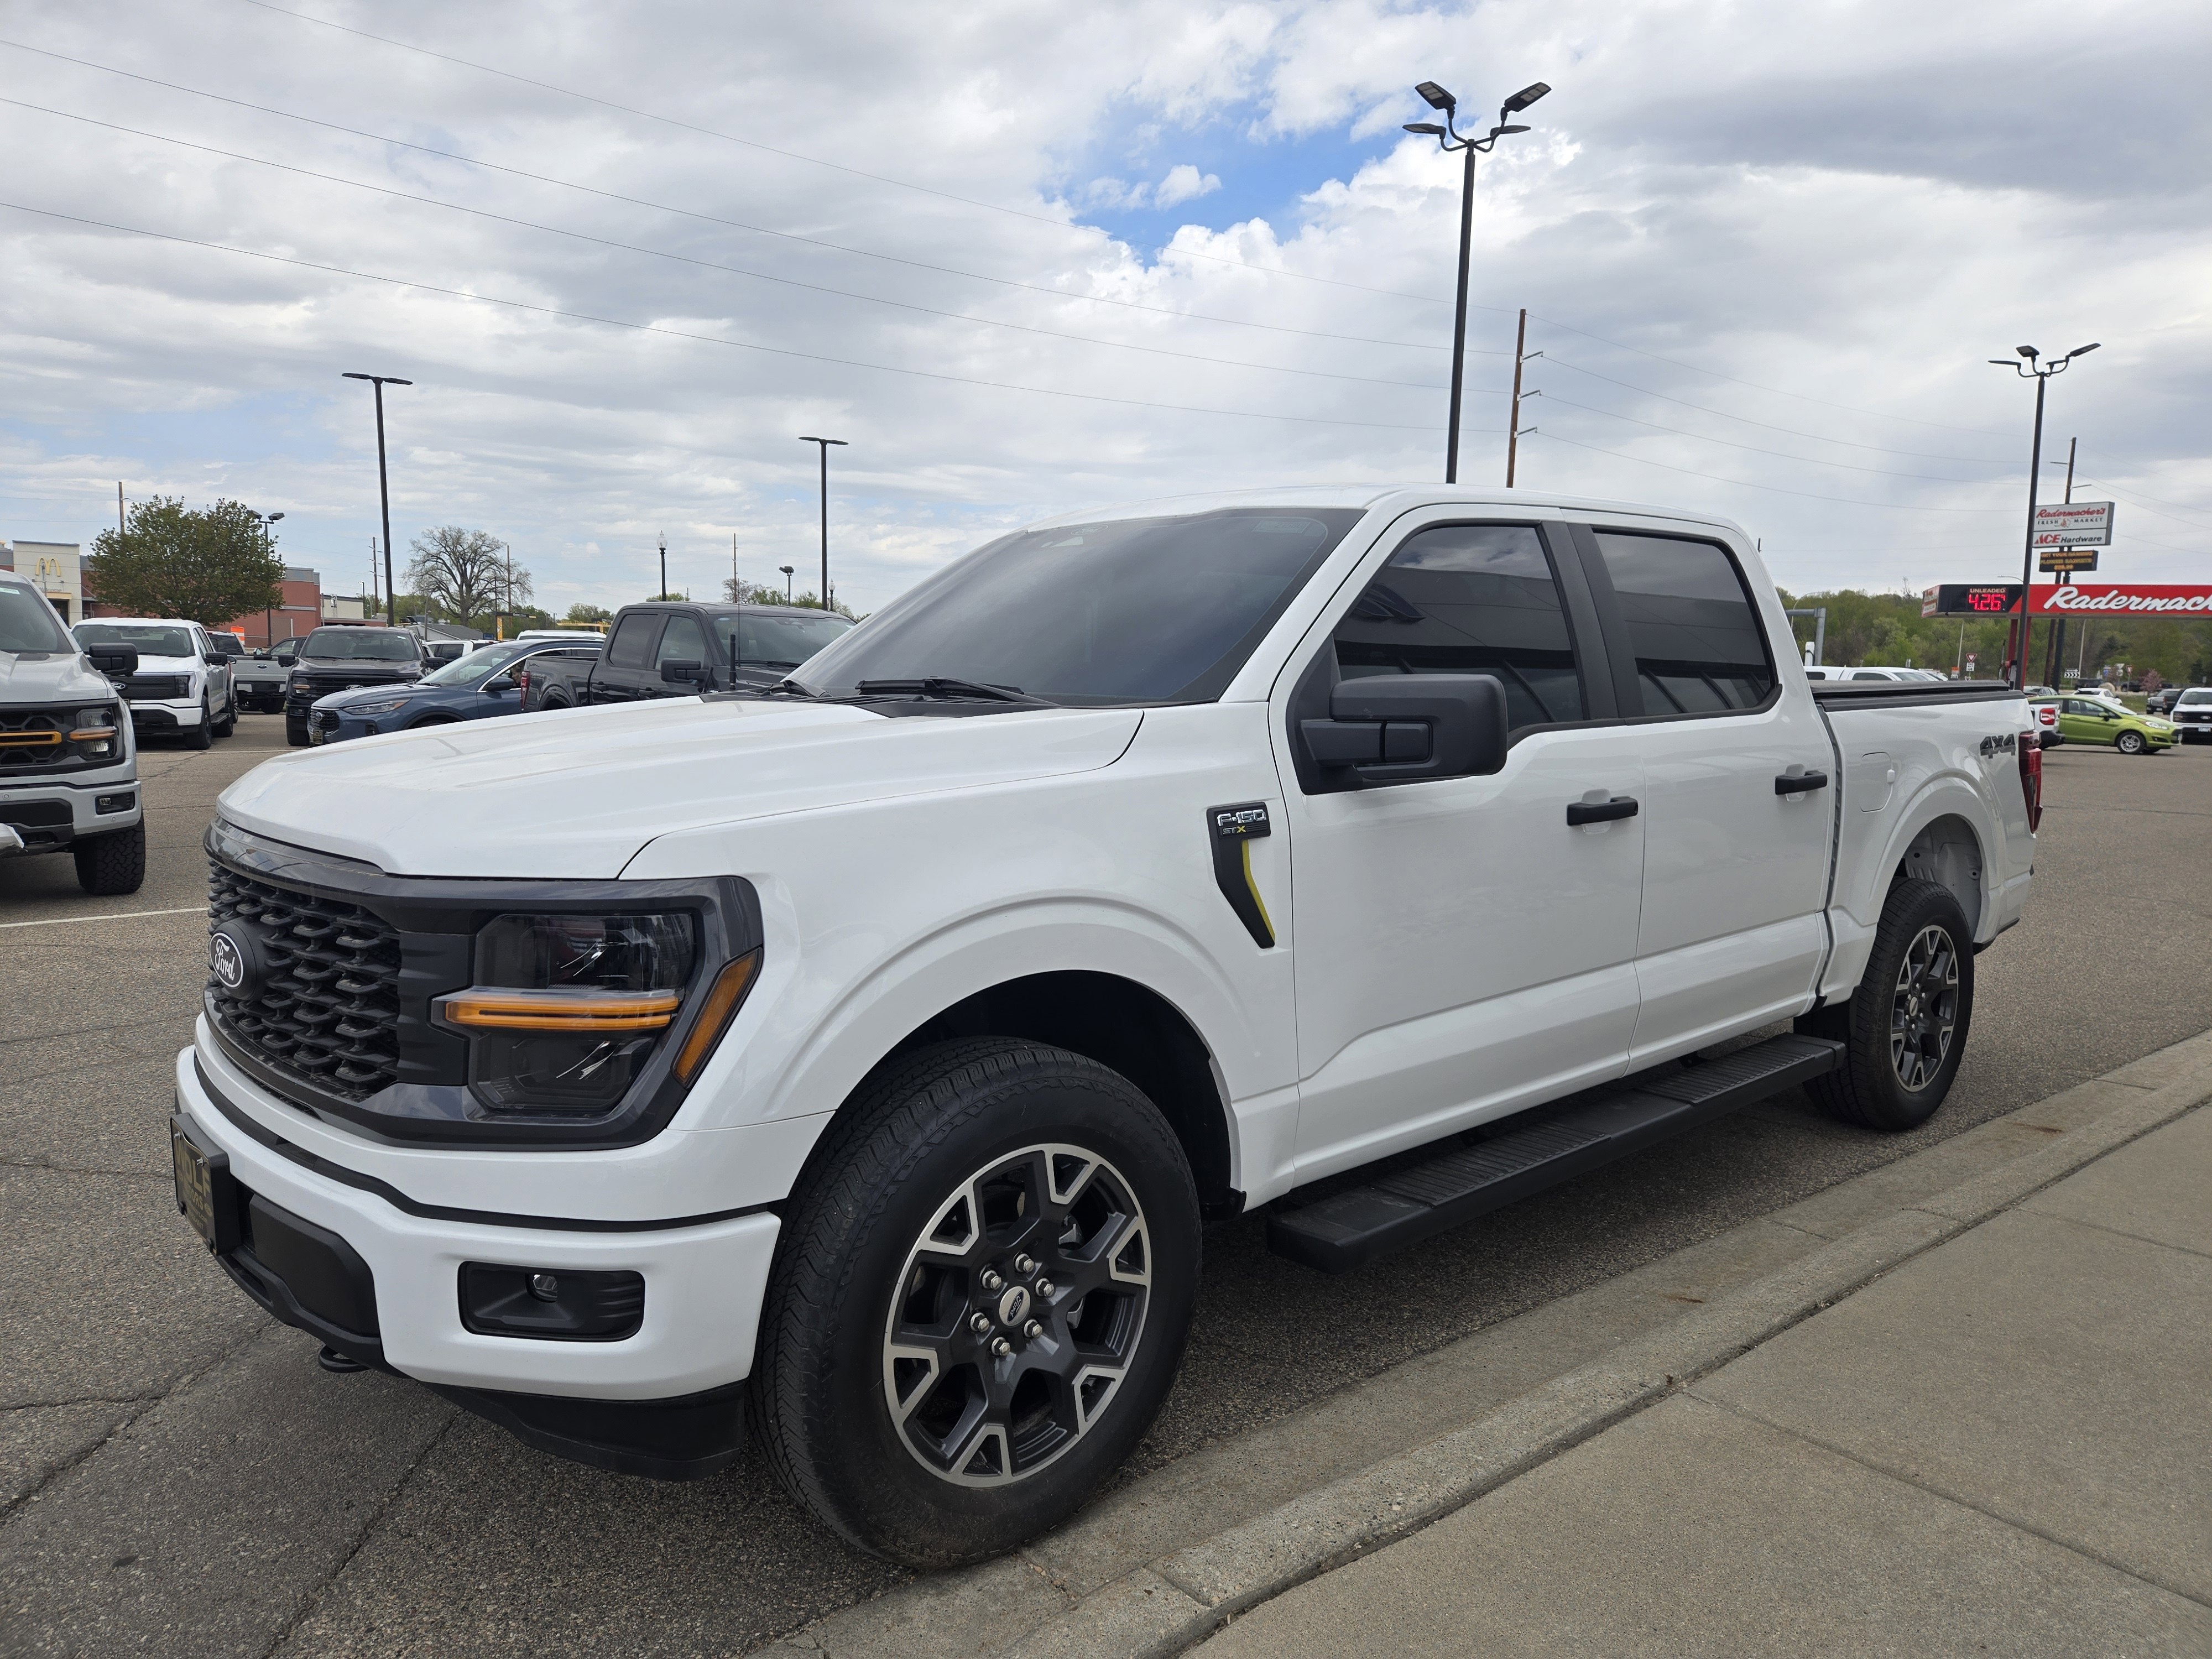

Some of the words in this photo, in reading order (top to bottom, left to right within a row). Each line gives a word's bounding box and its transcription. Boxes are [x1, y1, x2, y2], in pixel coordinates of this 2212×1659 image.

[2036, 507, 2105, 519] Radermacher's
[2034, 534, 2061, 544] ACE
[1217, 809, 1266, 826] F-150
[1223, 825, 1246, 834] STX
[215, 938, 236, 981] Ford
[1009, 1296, 1022, 1317] Ford
